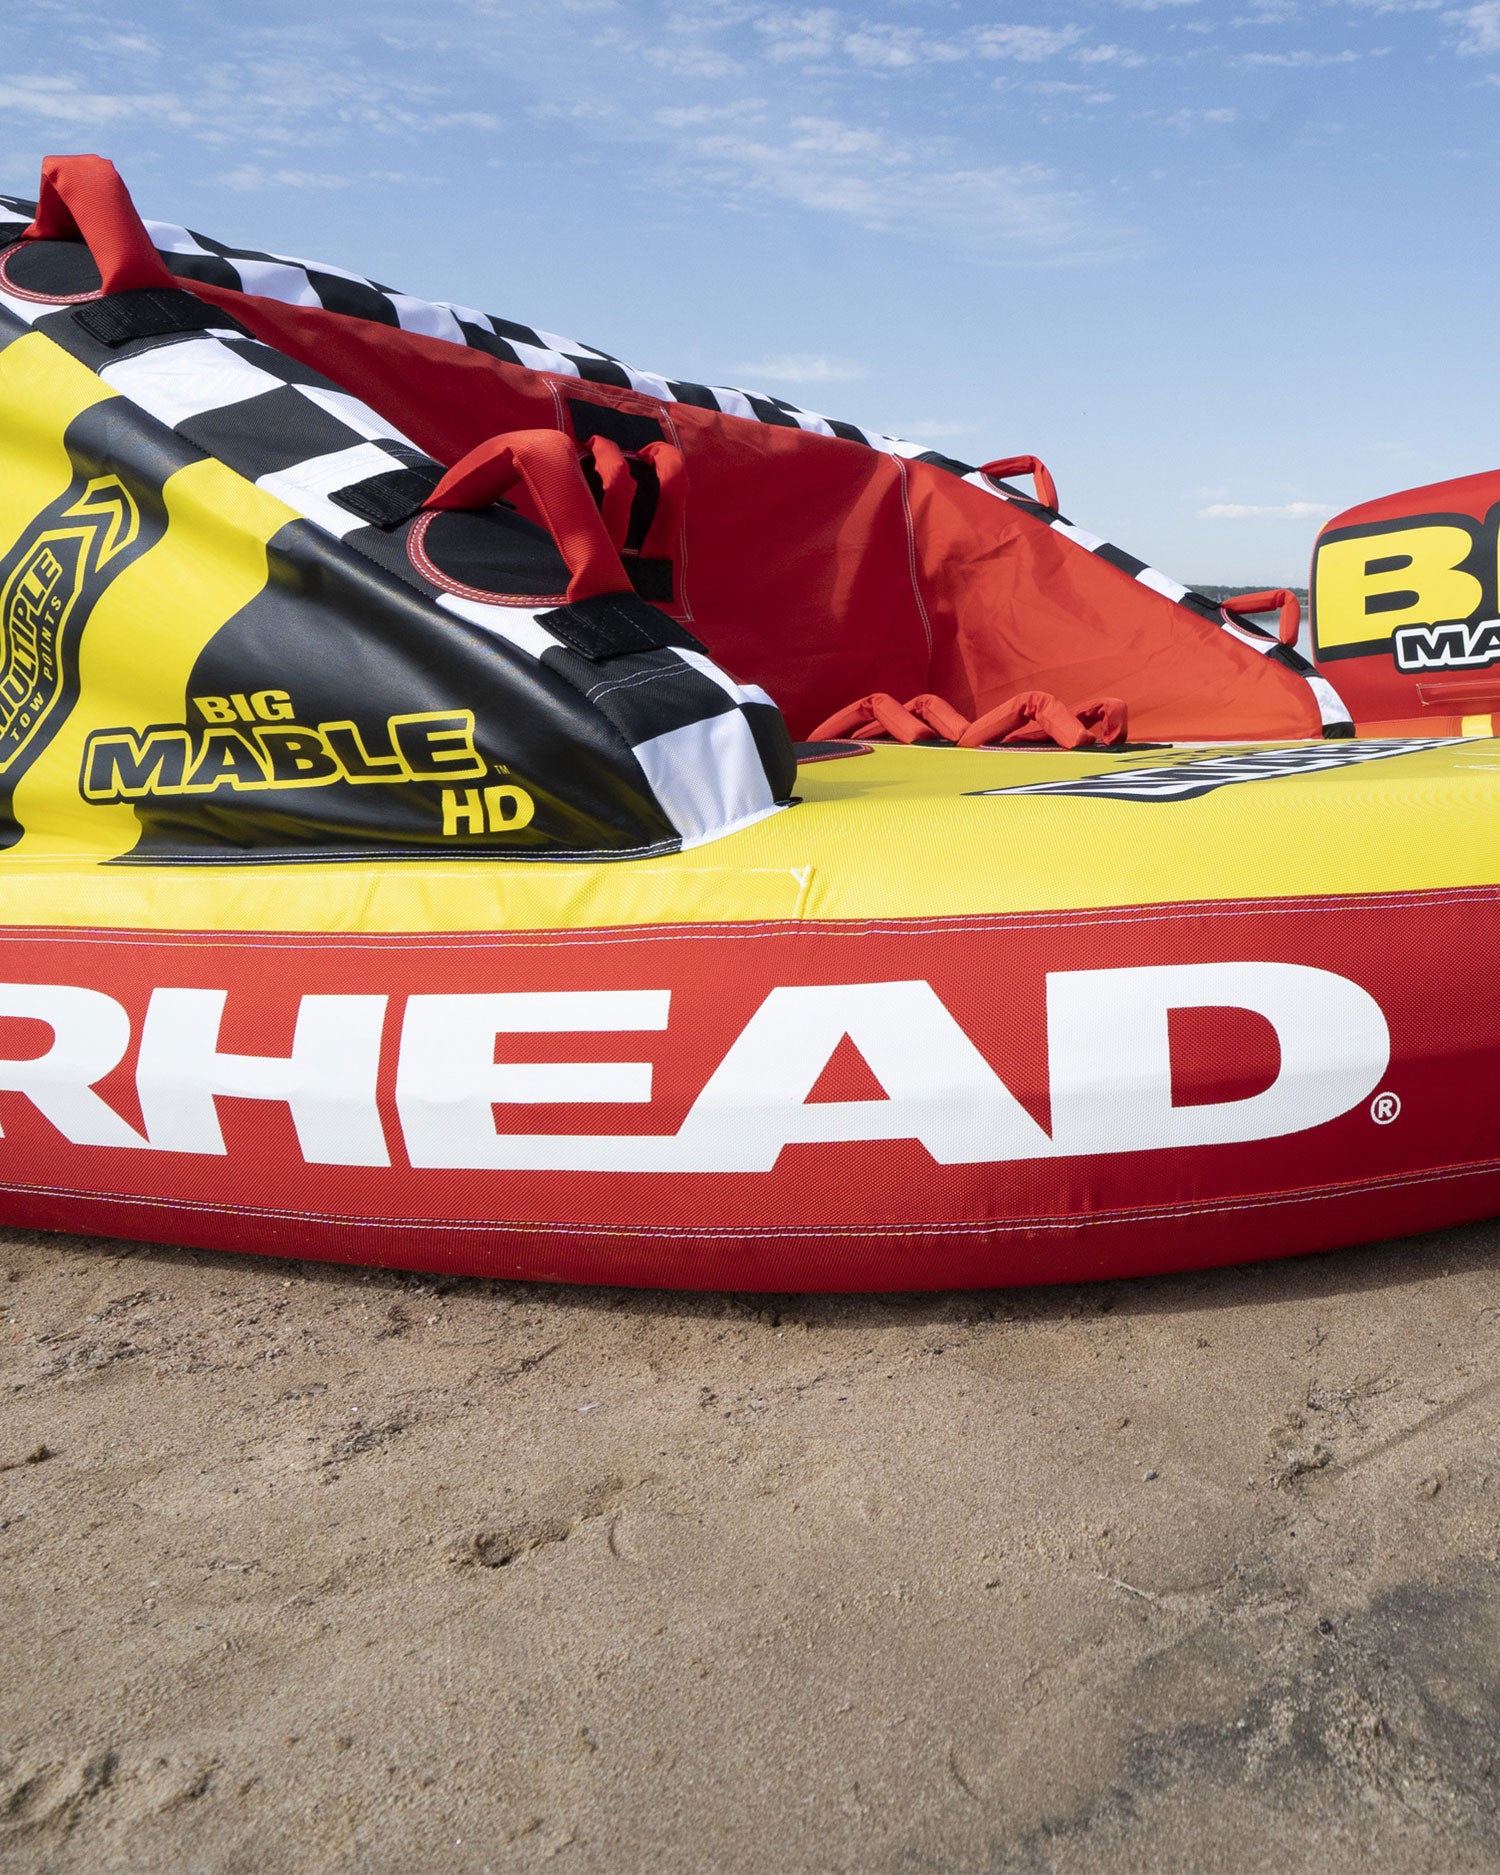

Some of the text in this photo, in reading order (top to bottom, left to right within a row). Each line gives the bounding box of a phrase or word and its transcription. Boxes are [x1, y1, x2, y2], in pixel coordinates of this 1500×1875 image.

[10, 596, 62, 741] TOW POINTS
[192, 690, 295, 725] BIG
[83, 709, 488, 799] MABLE
[441, 785, 535, 837] HD
[0, 961, 1391, 1173] RHEAD
